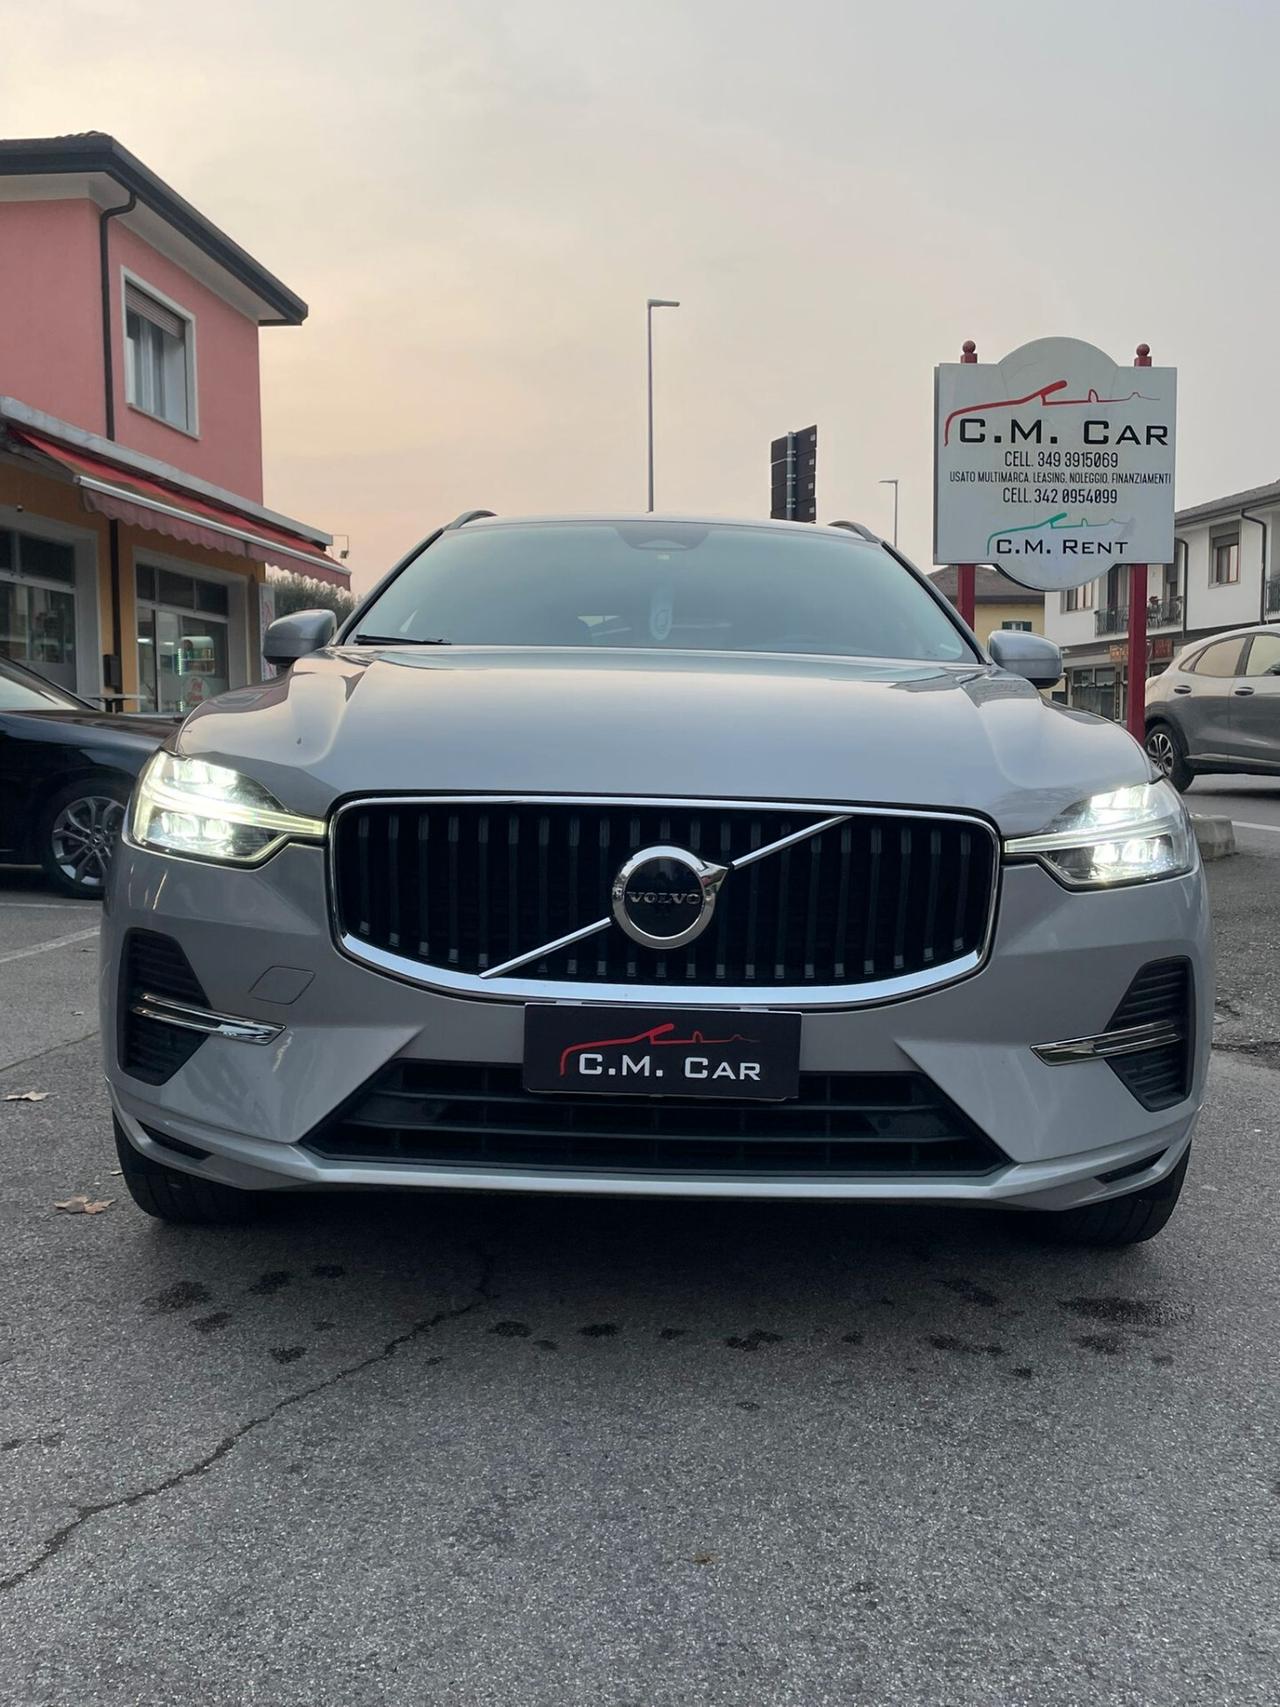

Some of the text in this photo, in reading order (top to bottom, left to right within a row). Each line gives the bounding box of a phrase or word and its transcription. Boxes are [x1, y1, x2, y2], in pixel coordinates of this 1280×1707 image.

[959, 418, 1058, 444] C.M.
[1004, 451, 1119, 468] CELL. 349 3915069
[949, 471, 976, 482] USATO
[1111, 473, 1171, 485] FINANZIAMENTI
[1002, 487, 1118, 504] CELL. 342 0954099
[996, 539, 1051, 554] C.M.
[626, 891, 701, 905] VOLVO
[578, 1053, 664, 1078] C.M.
